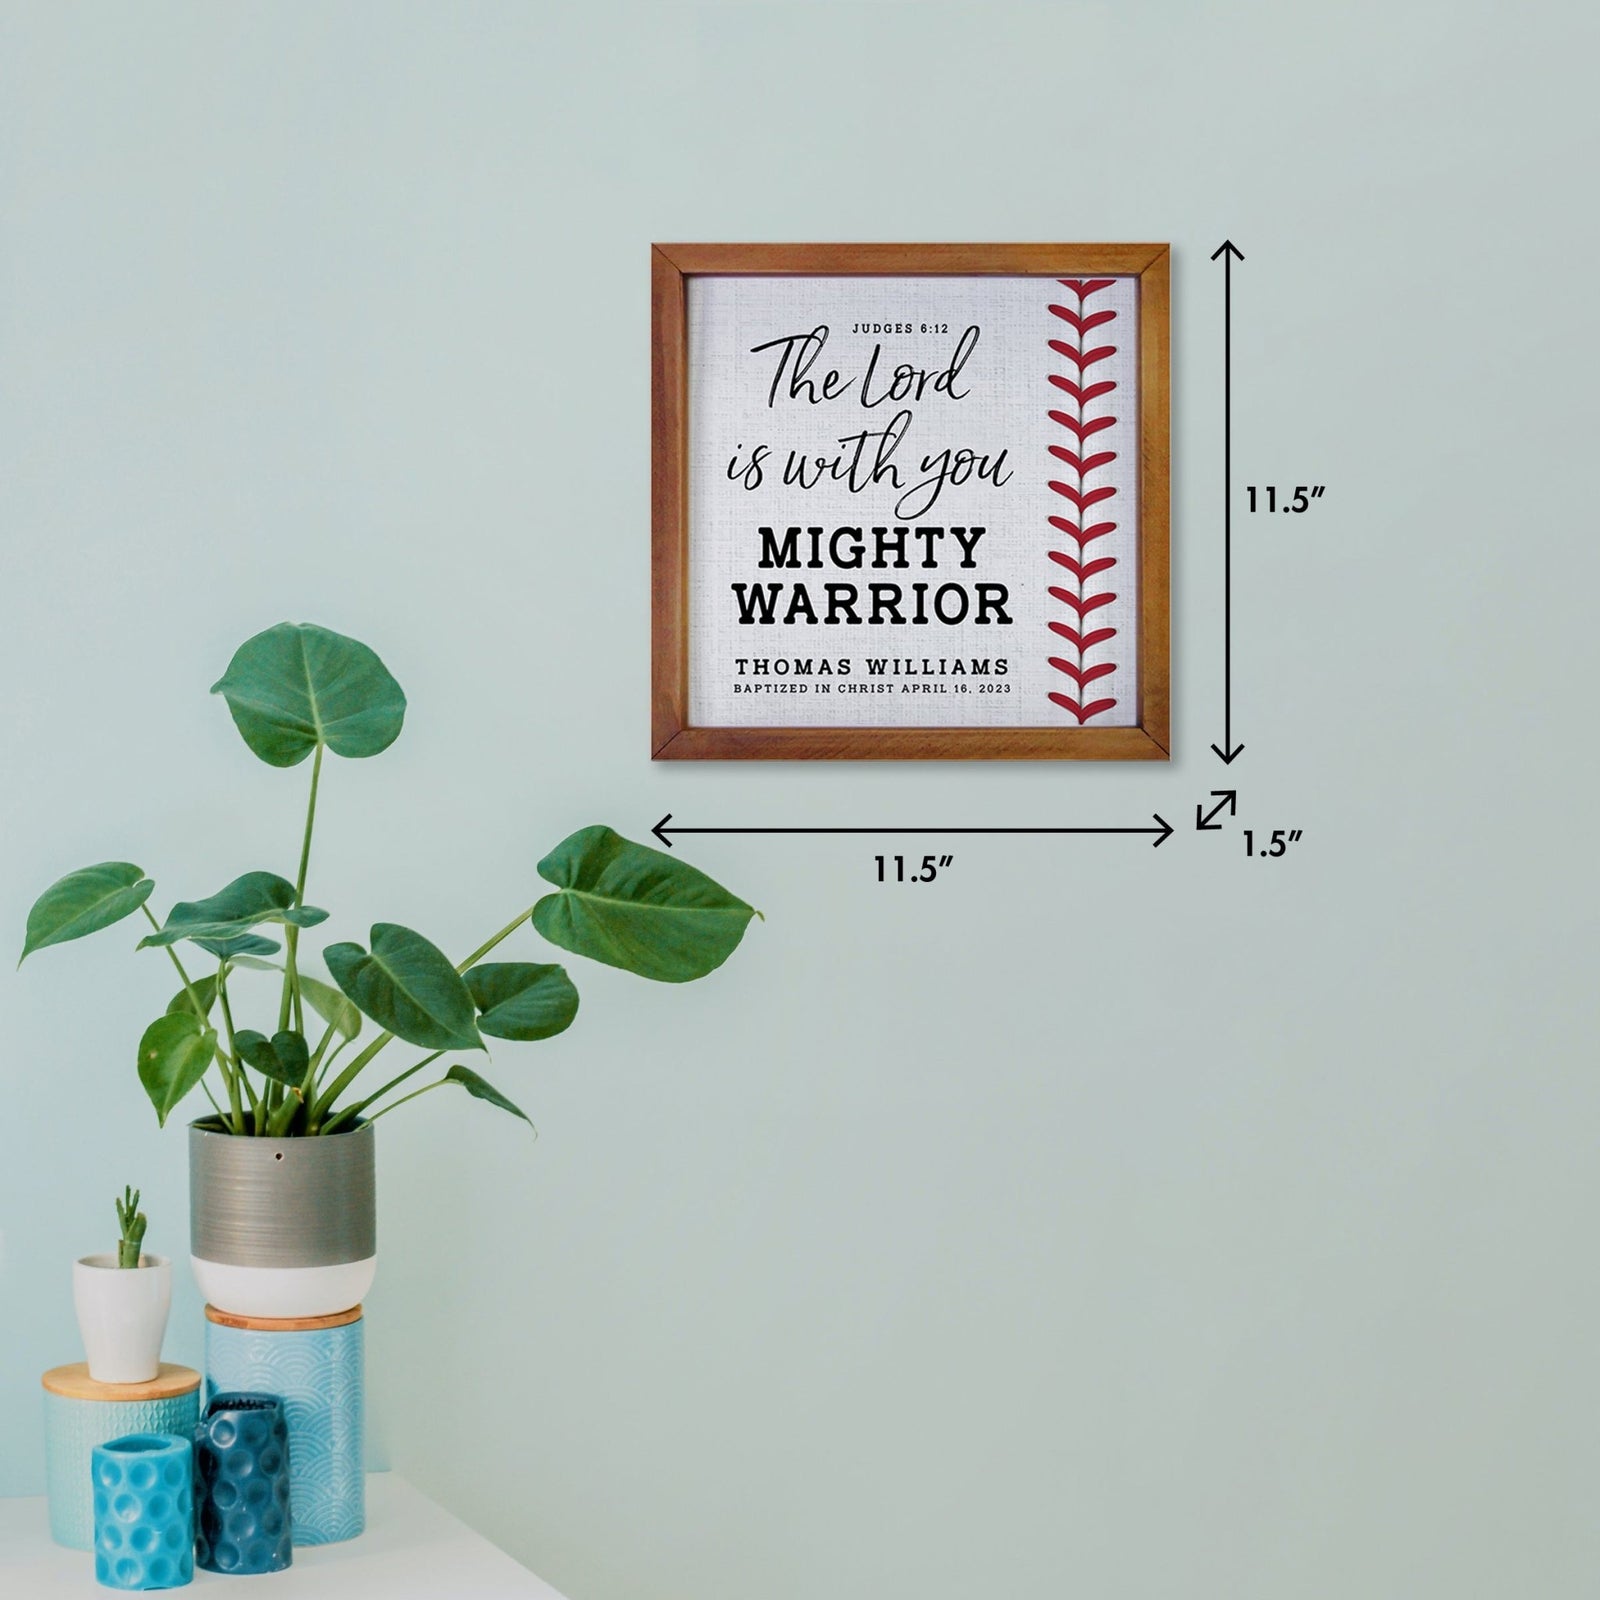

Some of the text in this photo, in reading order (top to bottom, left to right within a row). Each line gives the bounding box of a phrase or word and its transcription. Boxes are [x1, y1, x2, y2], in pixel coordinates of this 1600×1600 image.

[852, 323, 948, 334] JUDGES 6:12
[750, 325, 981, 408] The Lord
[727, 409, 1014, 521] is with you
[757, 526, 987, 569] MIGHTY
[731, 582, 1014, 625] WARRIOR
[733, 683, 808, 694] BAPTIZED
[815, 683, 831, 694] IN
[837, 683, 894, 694] CHRIST
[901, 683, 947, 694] APRIL
[978, 683, 1011, 694] 2023
[735, 658, 1009, 676] THOMAS WILLIAMS
